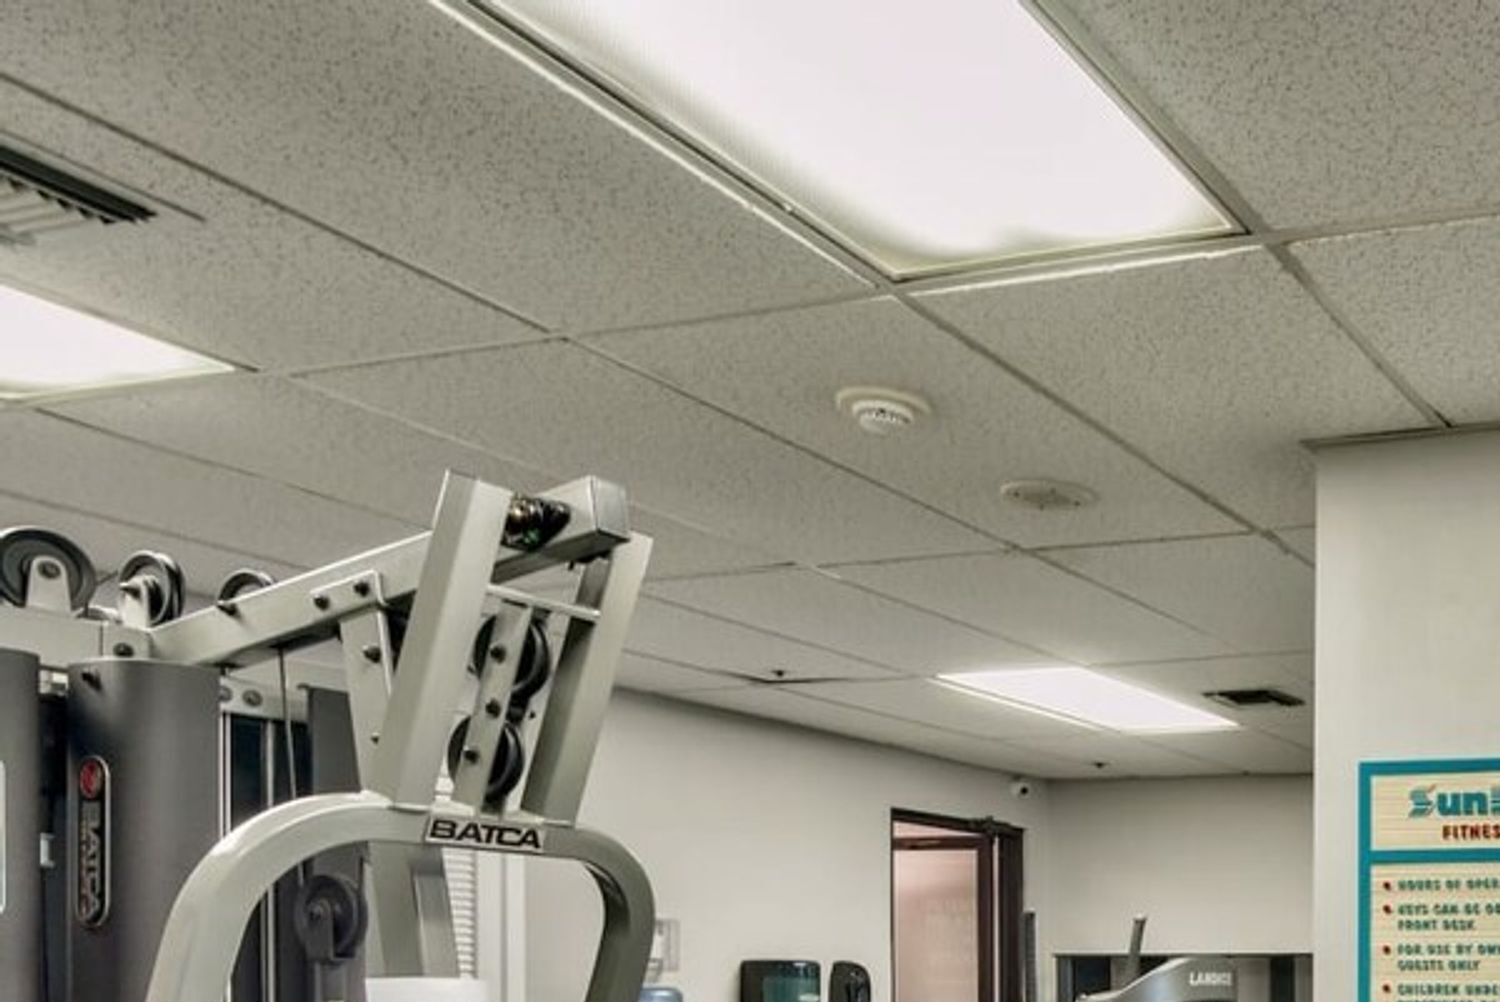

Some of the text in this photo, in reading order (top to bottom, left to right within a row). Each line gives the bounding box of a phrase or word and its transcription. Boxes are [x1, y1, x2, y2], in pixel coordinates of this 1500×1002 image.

[429, 819, 541, 849] BATCA
[1398, 879, 1441, 891] HOURS
[1445, 879, 1461, 890] OF
[1398, 903, 1429, 915] KEYS
[1433, 903, 1459, 915] CAN
[1464, 903, 1481, 915] BE
[1398, 919, 1476, 931] FRONT DESK
[1398, 944, 1421, 955] FOR
[1427, 944, 1451, 955] USE
[1456, 944, 1473, 955] BY
[1398, 960, 1480, 971] GUESTS ONLY
[1398, 984, 1460, 996] CHILDREN
